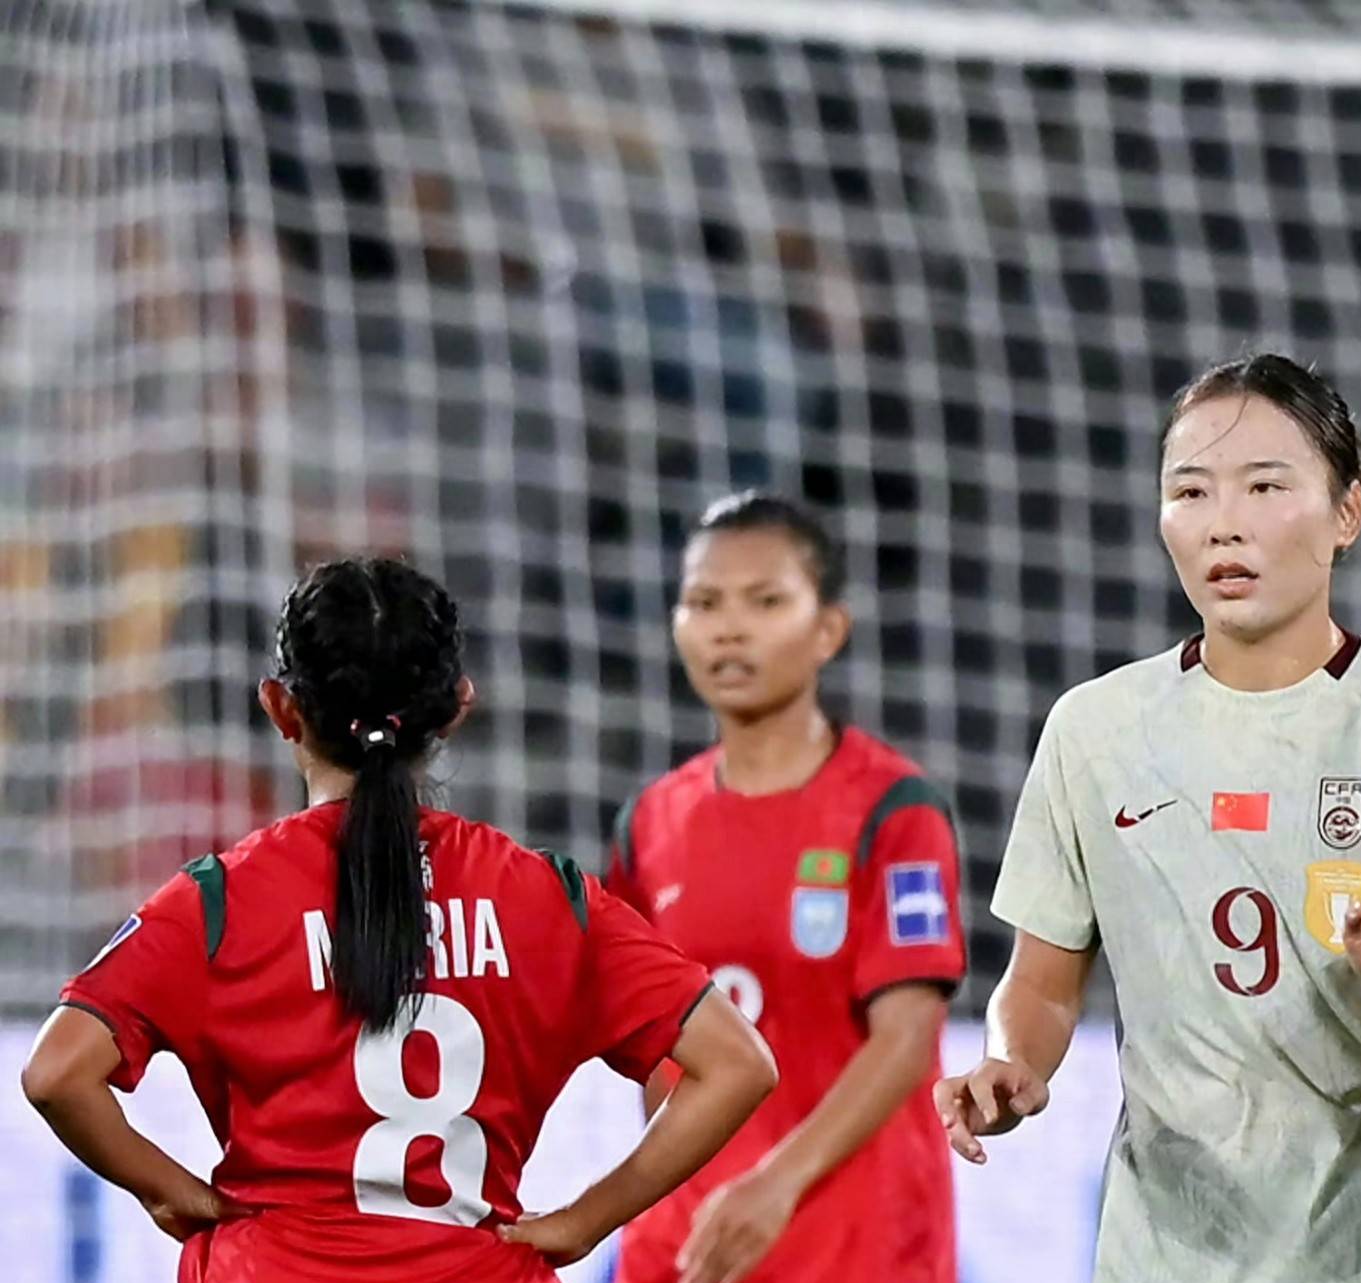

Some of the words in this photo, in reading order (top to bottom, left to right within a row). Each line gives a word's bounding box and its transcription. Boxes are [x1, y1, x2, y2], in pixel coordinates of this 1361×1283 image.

[303, 898, 510, 991] MRIA
[1212, 886, 1280, 996] 9
[353, 992, 493, 1228] 8
